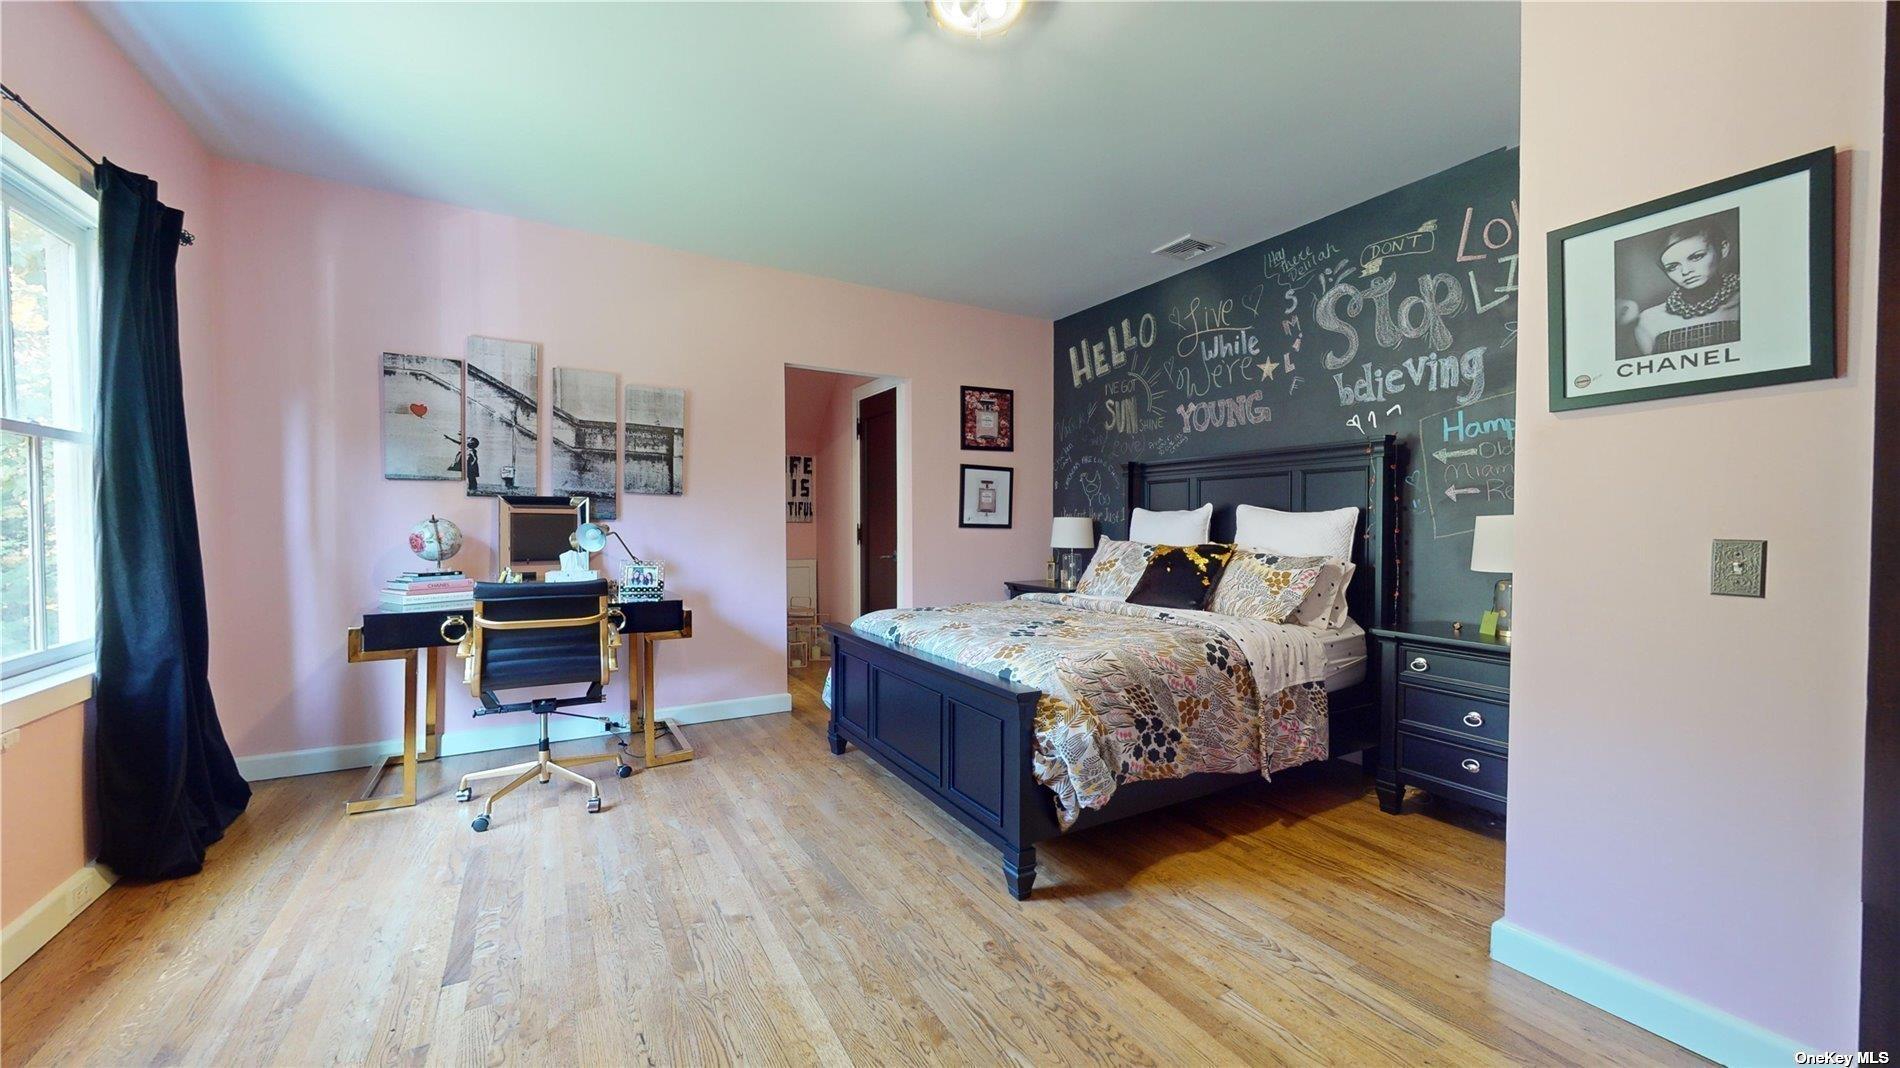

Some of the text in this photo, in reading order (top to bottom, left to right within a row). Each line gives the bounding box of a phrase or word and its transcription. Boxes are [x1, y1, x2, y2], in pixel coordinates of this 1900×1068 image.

[1177, 297, 1254, 357] Live
[1069, 313, 1157, 389] HELLO
[1616, 348, 1741, 378] CHANEL
[1104, 397, 1137, 433] SUN
[1176, 390, 1272, 433] YOUNG
[792, 479, 809, 497] IS
